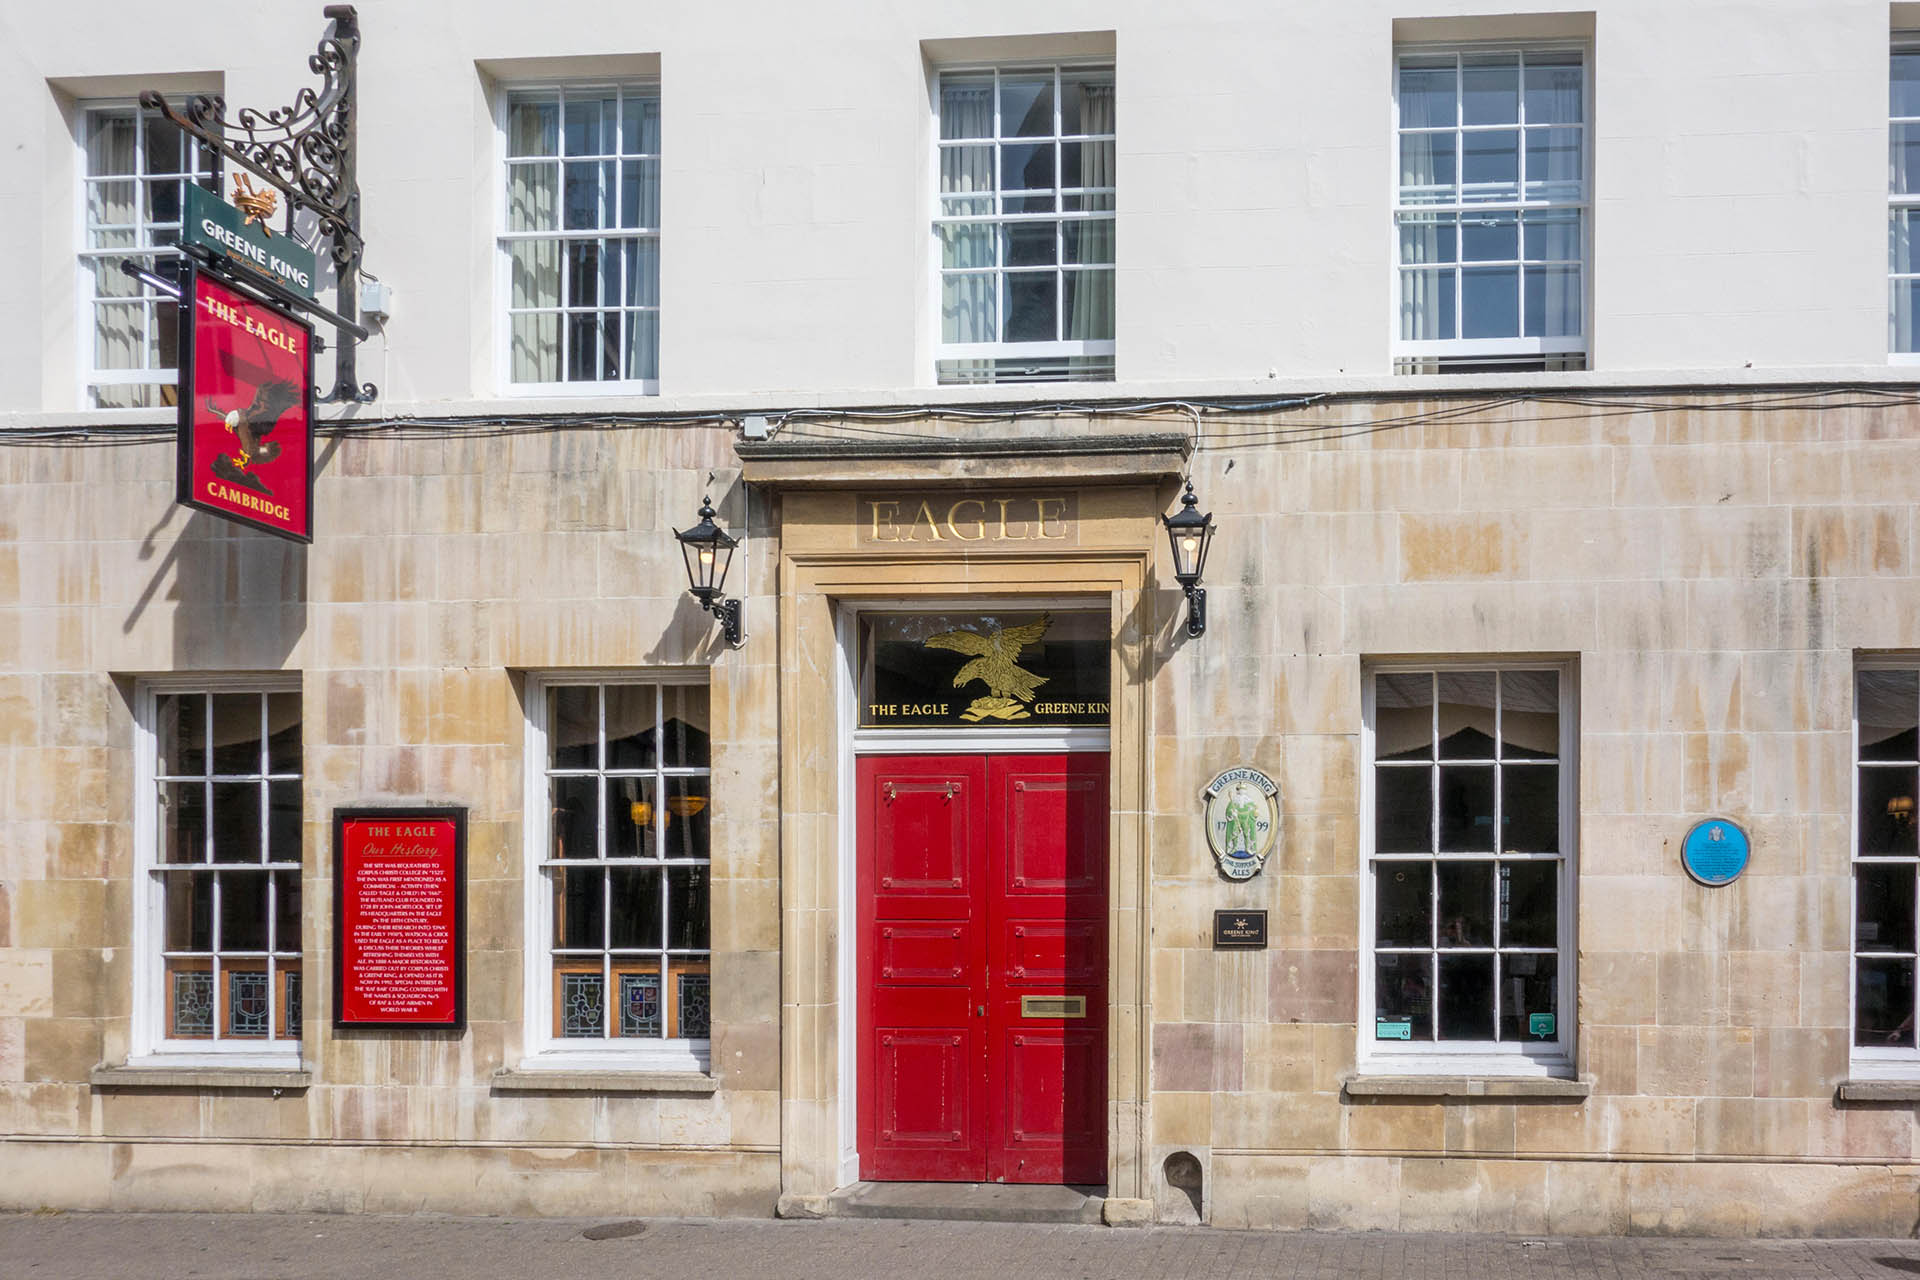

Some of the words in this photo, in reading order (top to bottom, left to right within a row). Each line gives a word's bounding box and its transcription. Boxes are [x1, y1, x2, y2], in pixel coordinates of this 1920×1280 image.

[202, 219, 266, 266] GREENE
[270, 255, 309, 288] KING
[206, 296, 239, 326] THE
[245, 315, 297, 354] EAGLE
[207, 481, 291, 521] CAMBRIDGE
[865, 498, 1067, 543] EAGLE
[869, 704, 898, 716] THE
[902, 703, 949, 716] EAGLE
[1034, 702, 1085, 714] GREENE
[1087, 702, 1111, 714] KIN
[1212, 770, 1248, 793] GREENE
[1249, 771, 1273, 793] KING
[368, 826, 390, 837] THE
[396, 826, 437, 837] EAGLE
[1217, 821, 1226, 831] 17
[1256, 820, 1269, 831] 99
[362, 842, 384, 856] Our
[390, 842, 438, 859] History
